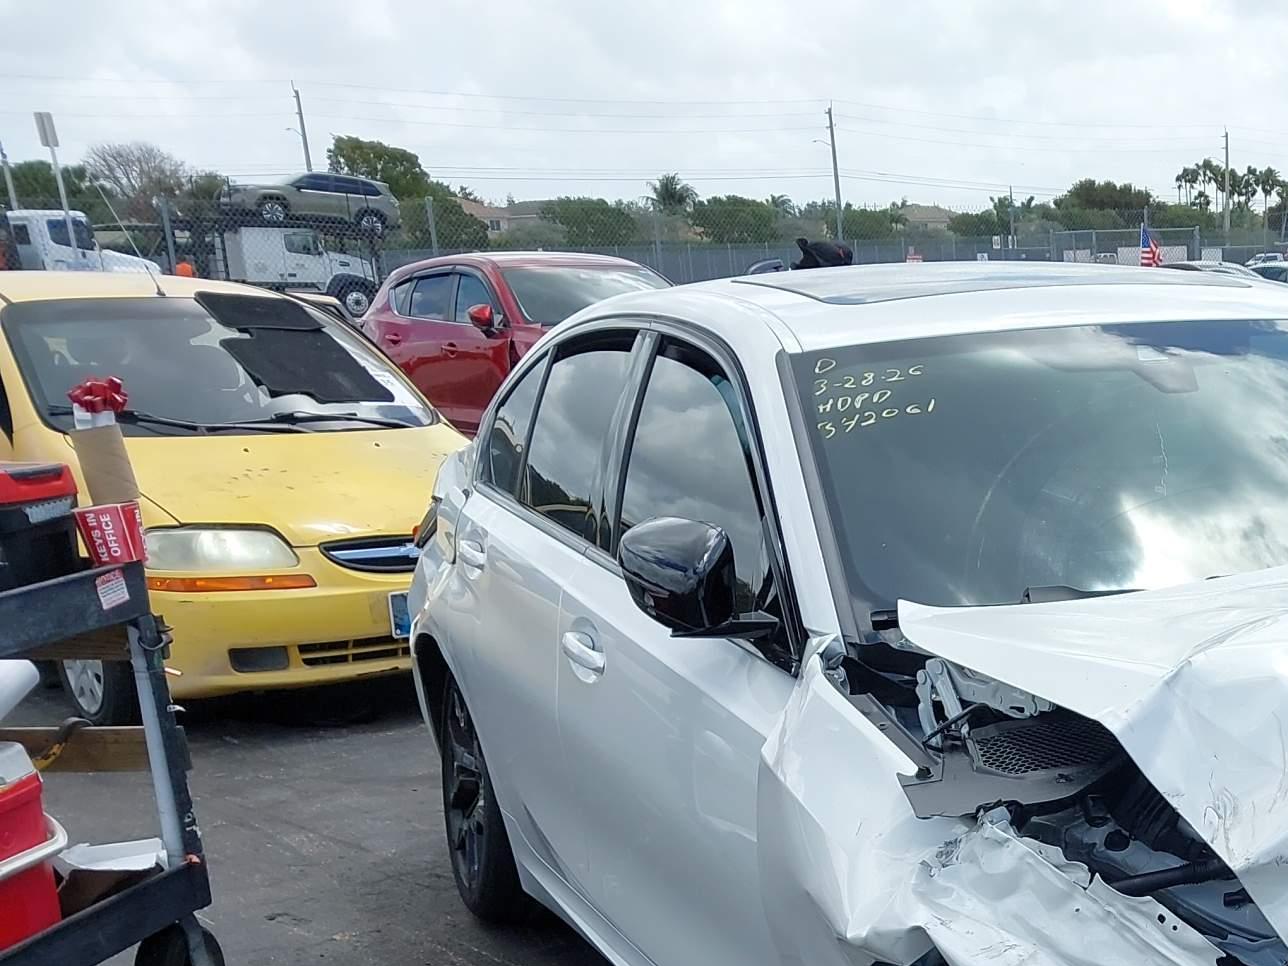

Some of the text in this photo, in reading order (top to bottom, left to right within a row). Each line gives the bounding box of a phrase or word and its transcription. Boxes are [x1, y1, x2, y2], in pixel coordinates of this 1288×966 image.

[85, 513, 98, 527] IN
[99, 513, 121, 557] OFFICE
[91, 529, 110, 562] KEYS
